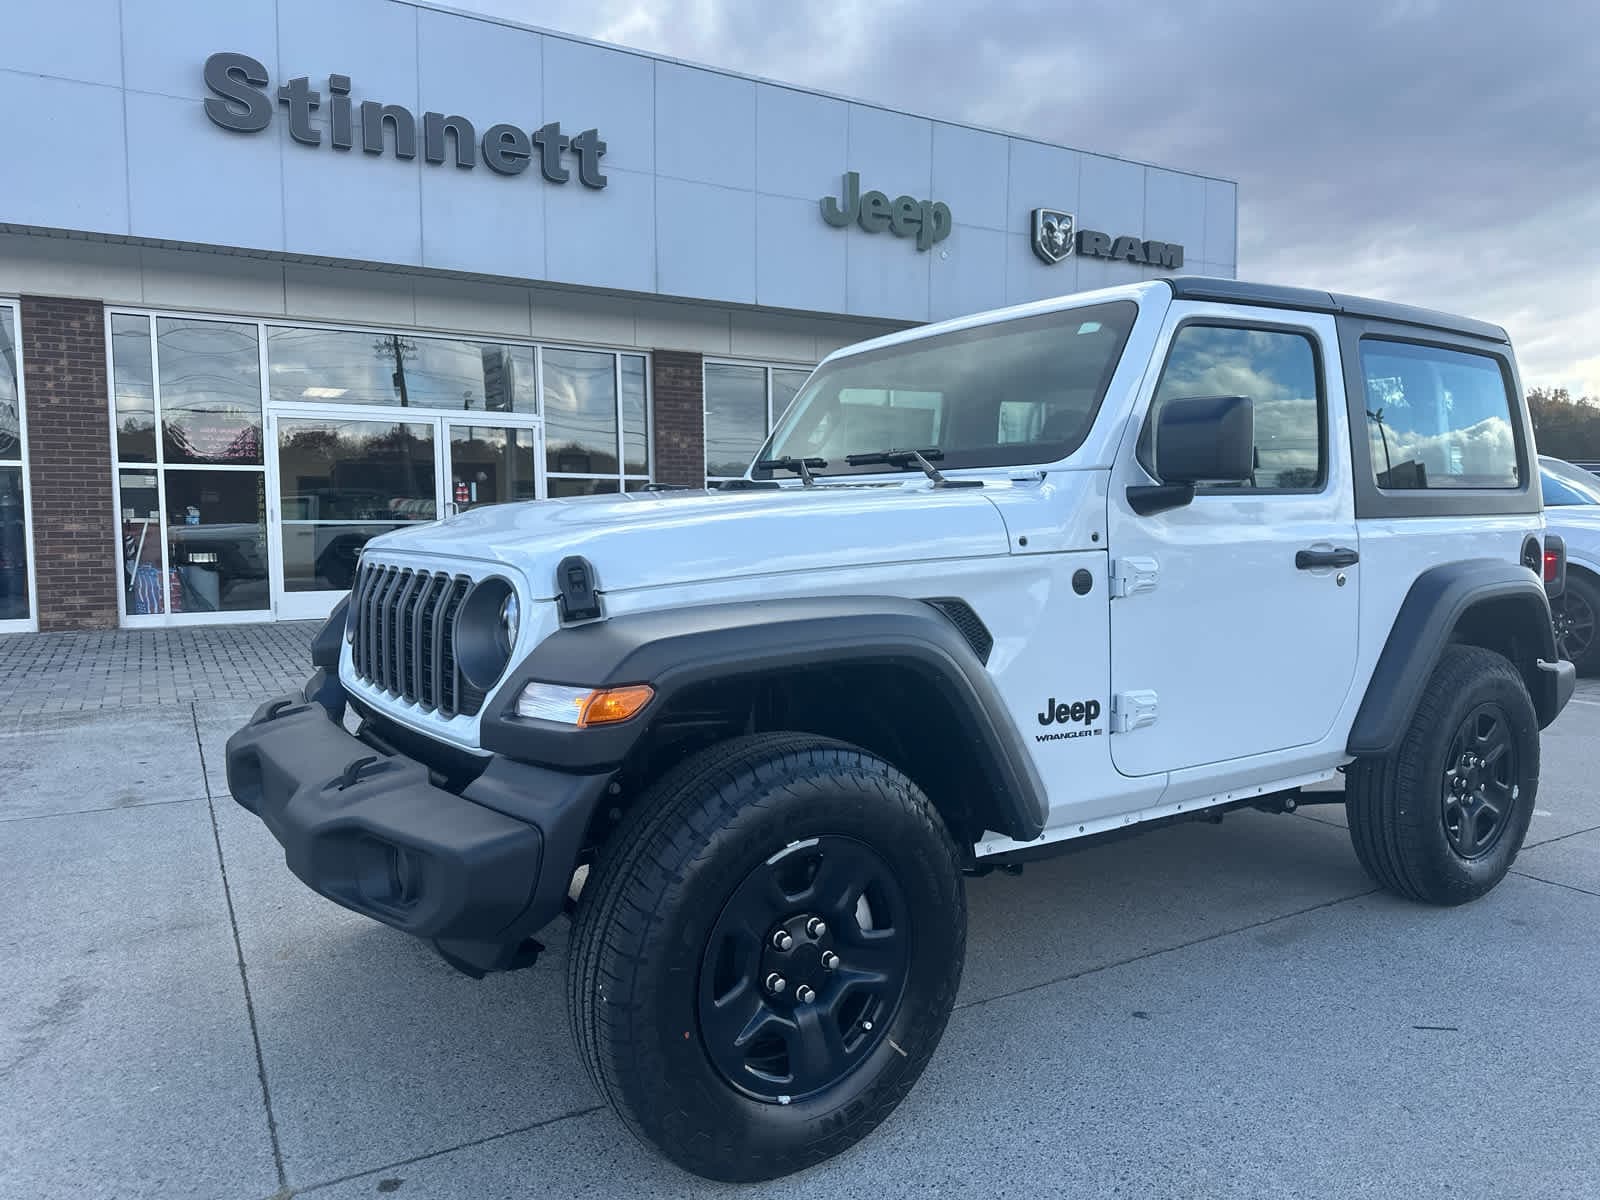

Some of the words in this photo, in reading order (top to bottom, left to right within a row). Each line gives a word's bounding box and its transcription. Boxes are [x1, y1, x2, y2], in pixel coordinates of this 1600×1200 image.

[203, 52, 608, 189] Stinnett
[820, 171, 952, 251] Jeep
[1076, 230, 1184, 270] RAM
[1038, 698, 1101, 726] Jeep
[1036, 729, 1092, 743] WRANGLER
